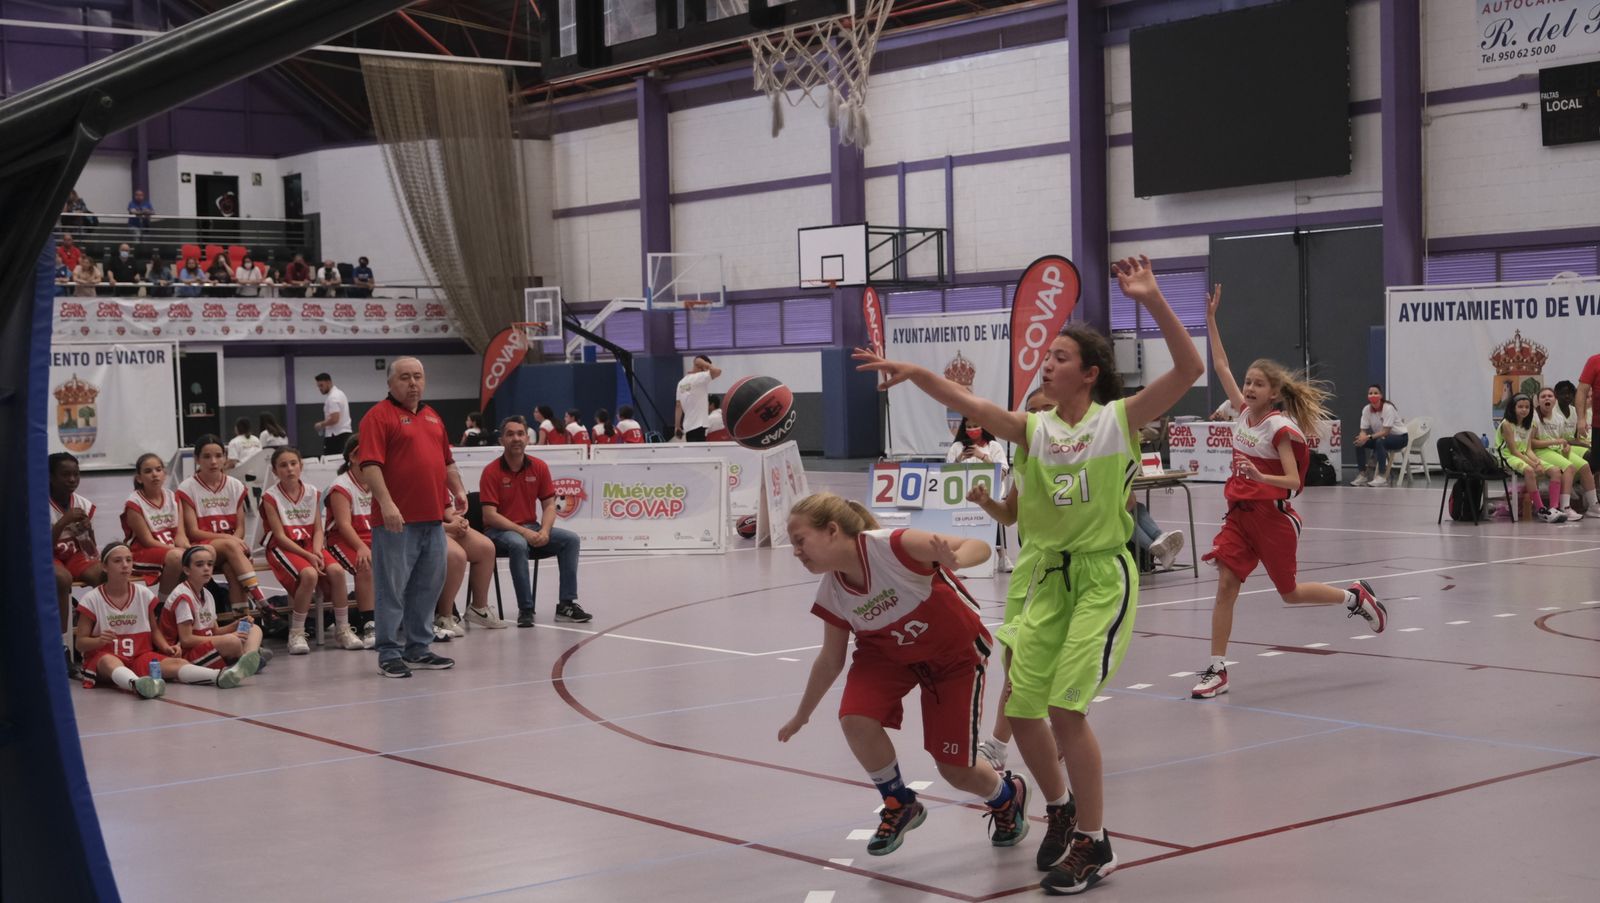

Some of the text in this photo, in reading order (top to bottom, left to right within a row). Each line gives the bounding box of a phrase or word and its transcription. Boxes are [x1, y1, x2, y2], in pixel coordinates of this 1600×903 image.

[1482, 0, 1563, 14] AUTOCA
[1527, 8, 1577, 43] del
[1482, 43, 1557, 64] Tel. 950 62 50 00
[1541, 91, 1559, 100] FALTAS
[1546, 98, 1583, 112] LOCAL
[1018, 265, 1065, 371] COVAP
[1399, 297, 1538, 323] AYUNTAMIENTO
[1545, 297, 1570, 318] DE
[892, 325, 970, 344] AYUNTAMIENTO
[974, 324, 988, 341] DE
[96, 351, 113, 366] DE
[116, 350, 166, 365] VIATOR
[485, 332, 524, 390] COVAP
[761, 410, 797, 445] COVAP
[1168, 425, 1192, 437] COPA
[1209, 425, 1233, 437] COPA
[1050, 441, 1088, 455] COVA
[1207, 437, 1233, 448] COVA
[603, 482, 685, 499] Muévete
[928, 479, 938, 492] 2
[1053, 468, 1090, 506] 21
[610, 499, 683, 518] COVAP
[863, 596, 899, 621] COVAP
[109, 619, 137, 627] COVAP
[112, 638, 134, 657] 19
[1064, 688, 1081, 703] 21
[942, 742, 959, 755] 20
